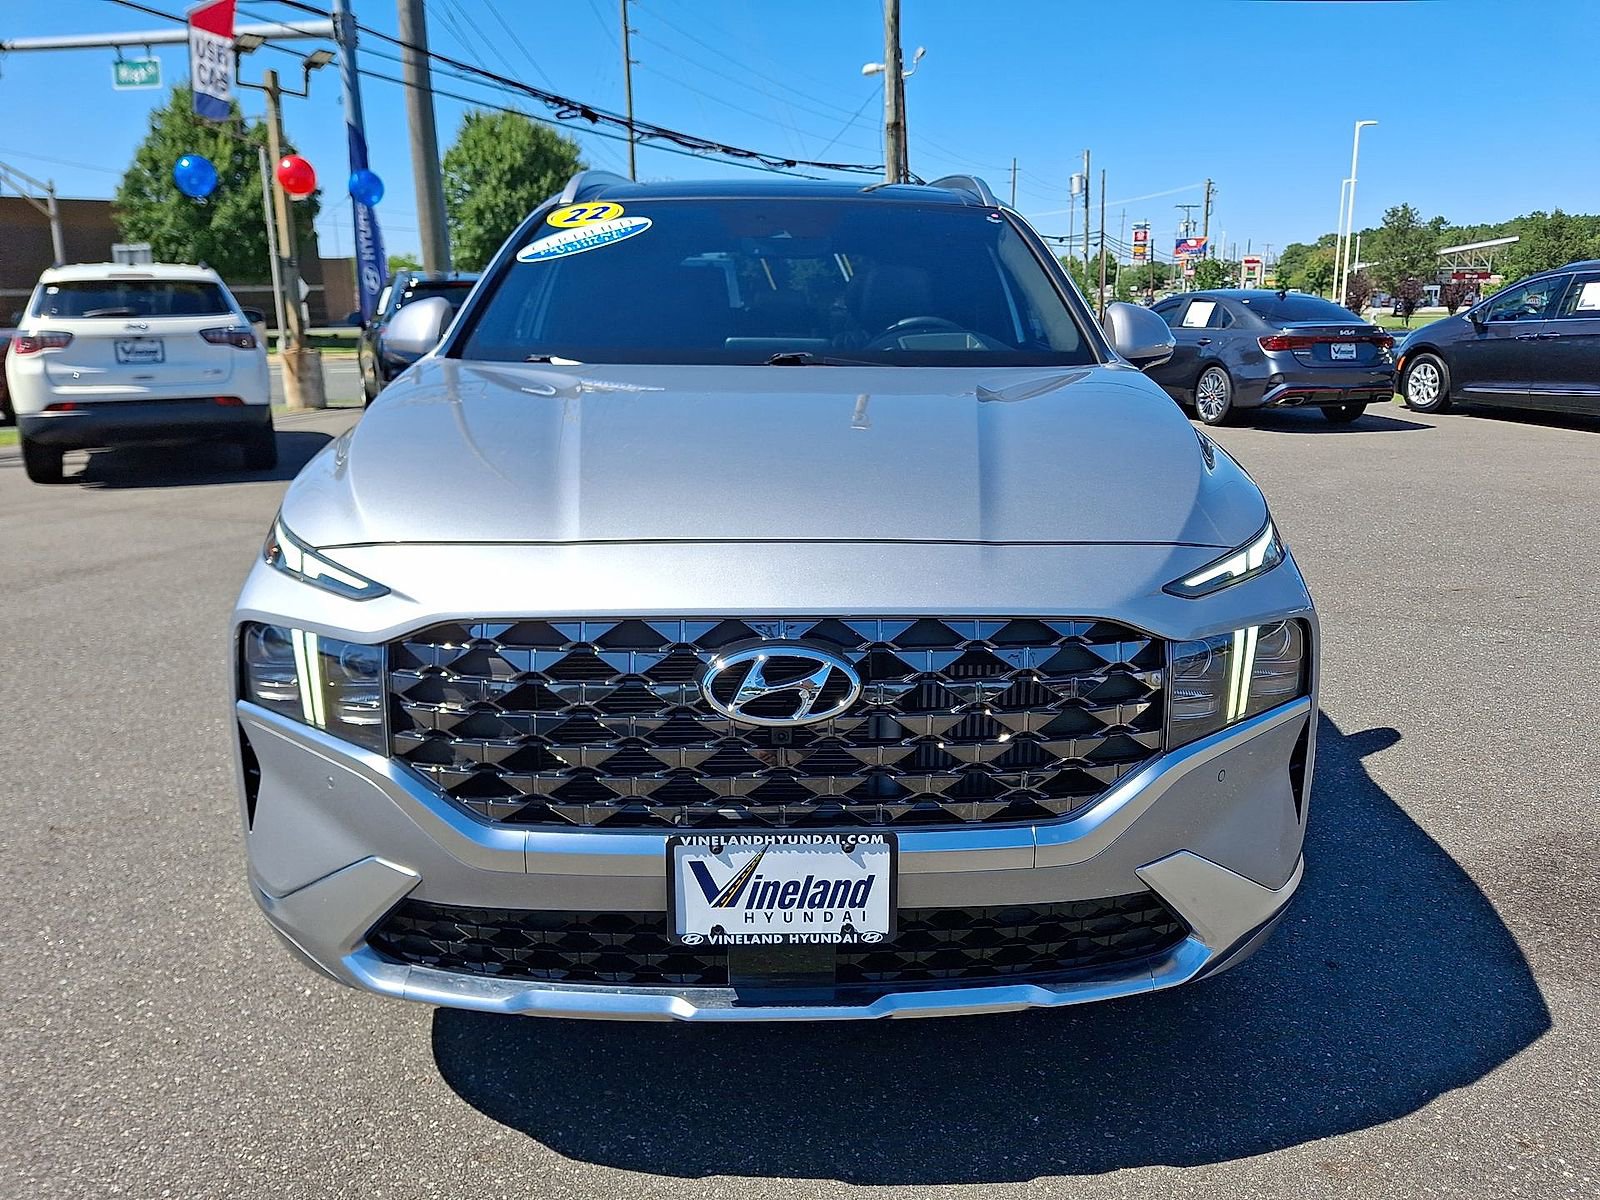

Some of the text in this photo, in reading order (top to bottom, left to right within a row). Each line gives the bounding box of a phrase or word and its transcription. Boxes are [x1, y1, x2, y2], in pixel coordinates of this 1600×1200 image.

[564, 207, 610, 222] 22
[680, 834, 884, 846] VINELANDHYUNDAI.COM
[688, 844, 876, 909] Vineland
[745, 911, 866, 923] HYUNDAI
[708, 933, 858, 945] VINELAND HYUNDAI
